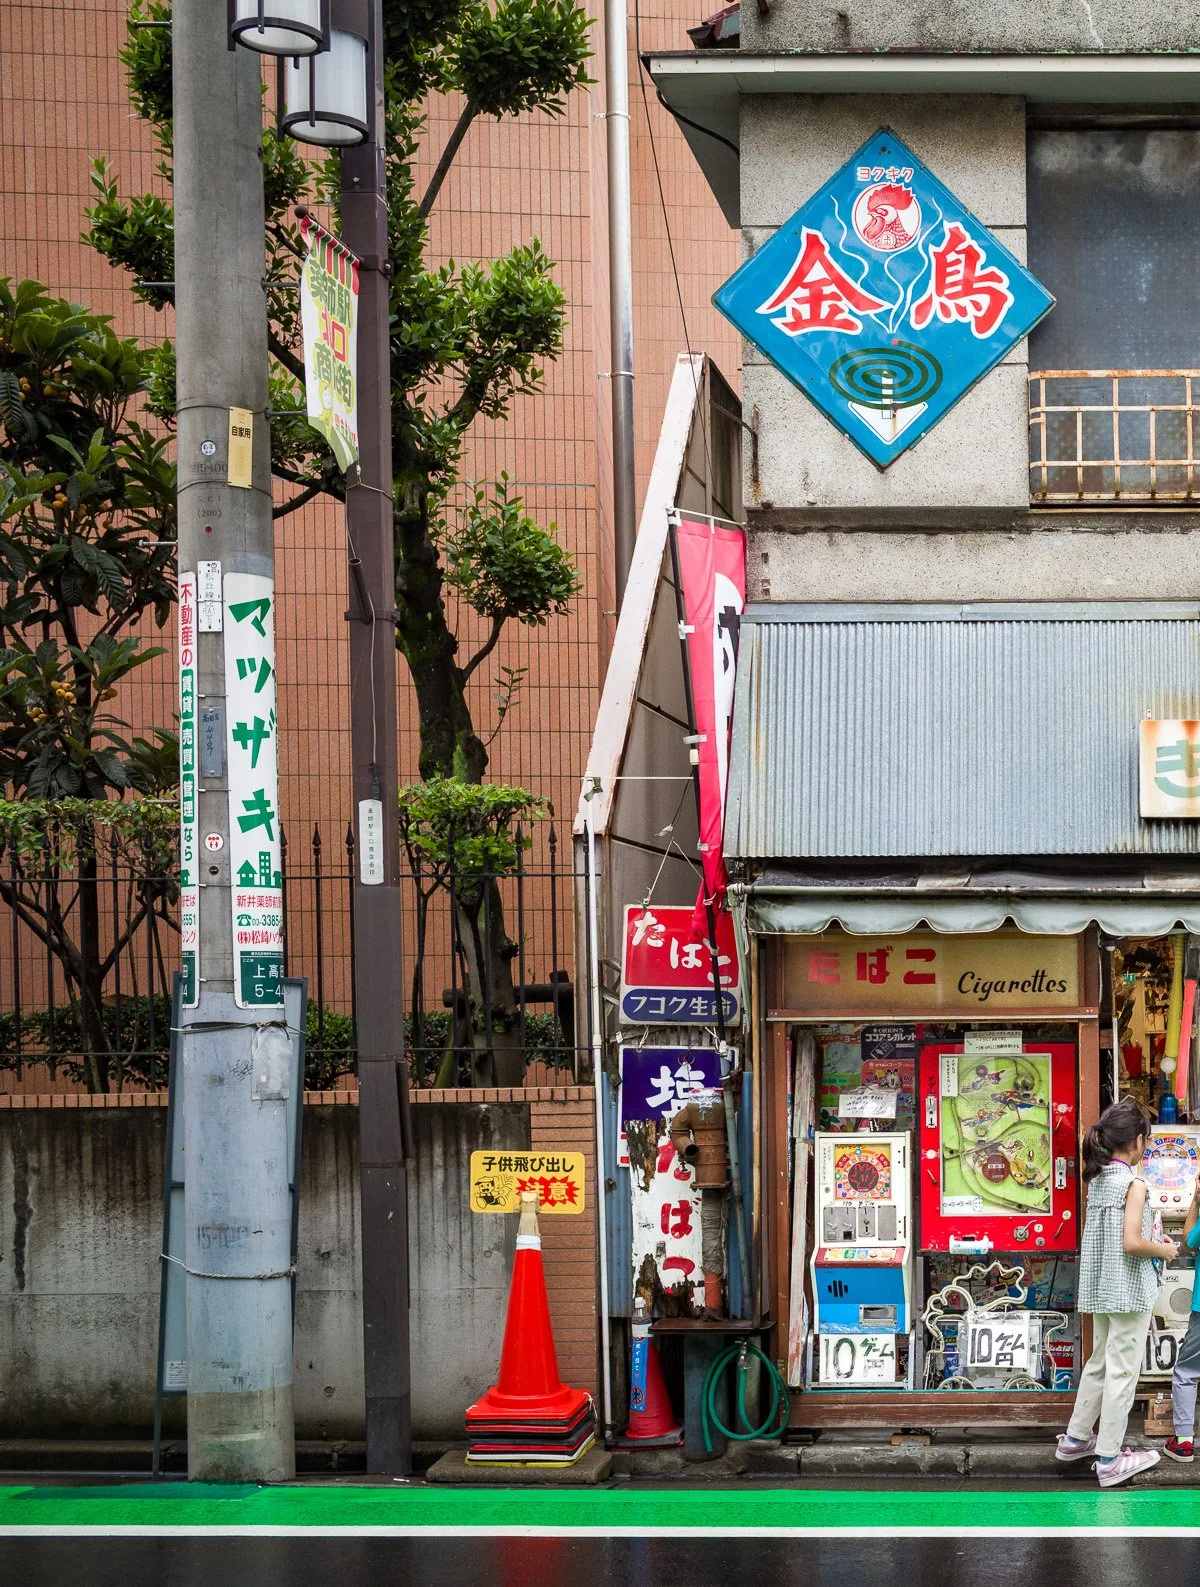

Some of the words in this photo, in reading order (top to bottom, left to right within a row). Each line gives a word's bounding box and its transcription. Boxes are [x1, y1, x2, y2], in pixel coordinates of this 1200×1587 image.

[856, 166, 914, 182] ヨクキク
[755, 220, 1014, 338] 金鳥
[231, 426, 251, 438] 自家用
[181, 583, 193, 667] 不動産の
[228, 597, 275, 842] マツザキ
[182, 727, 193, 765] 売買
[183, 780, 193, 818] 管理
[184, 828, 193, 862] なら
[807, 945, 936, 985] たばこ
[957, 969, 1067, 1001] Cigarettes
[630, 996, 732, 1017] フコク生命
[482, 1157, 574, 1172] 子供飛び出し
